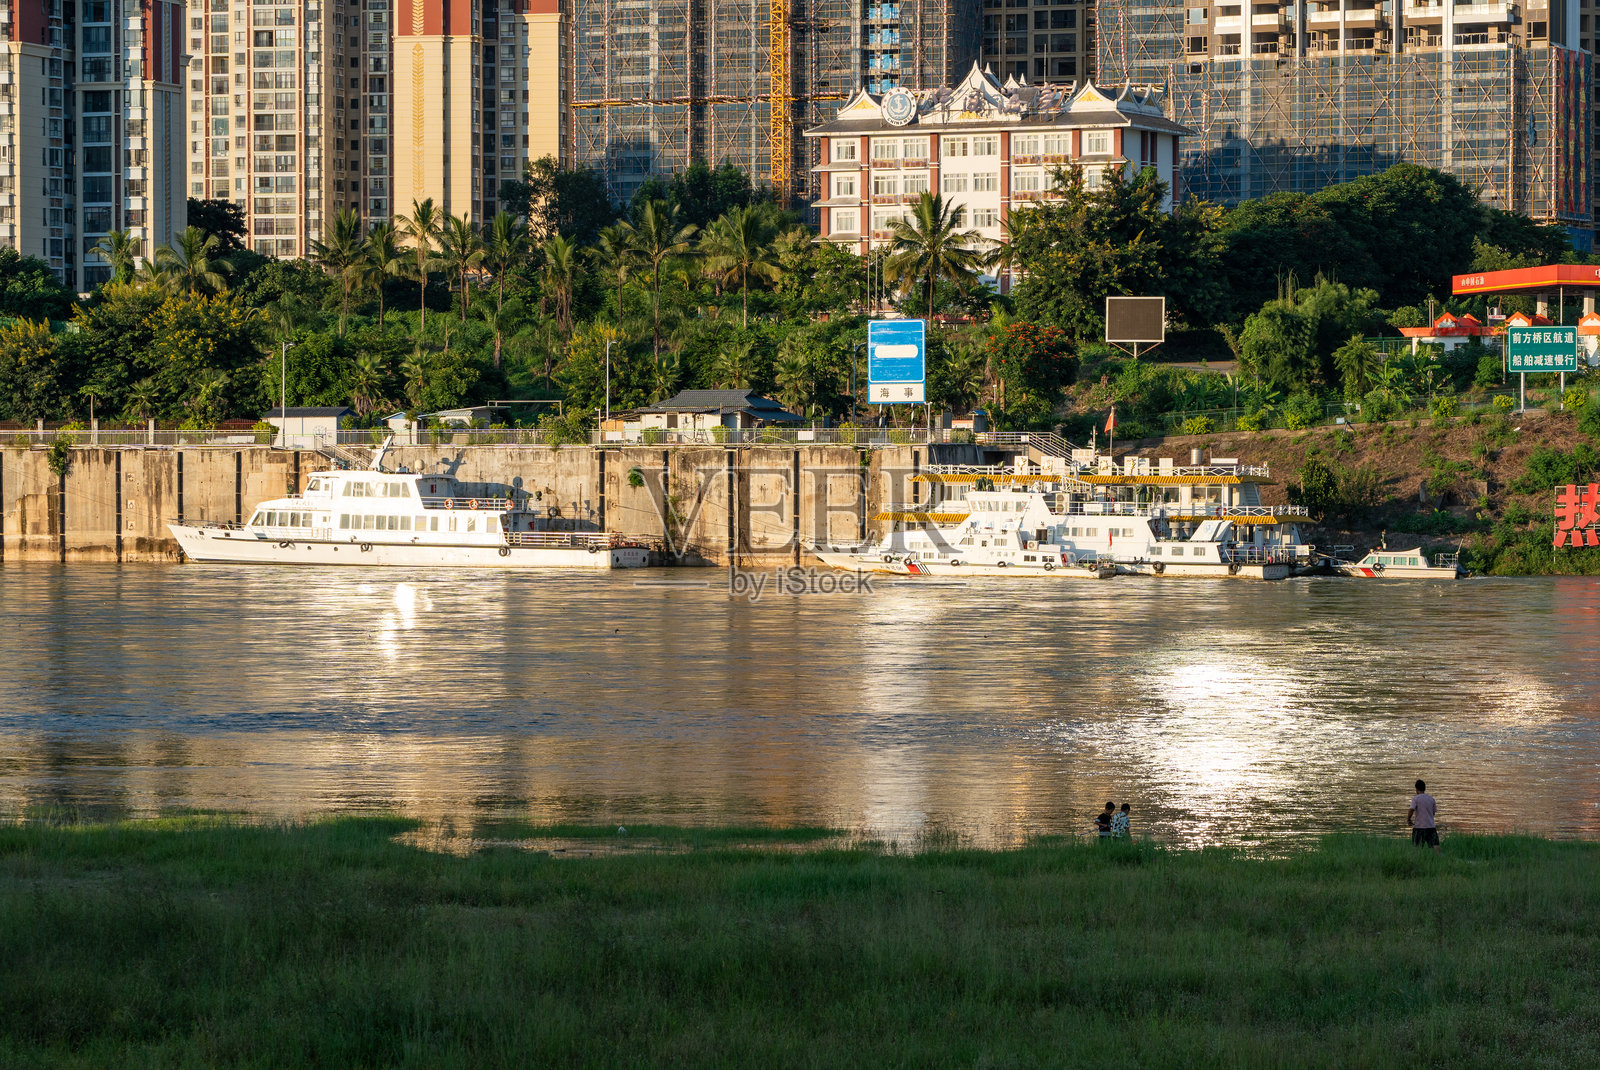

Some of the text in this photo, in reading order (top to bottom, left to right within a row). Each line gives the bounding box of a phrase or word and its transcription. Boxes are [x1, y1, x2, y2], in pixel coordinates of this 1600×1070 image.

[1512, 332, 1574, 344] 前方桥区航道
[1512, 354, 1575, 366] 船舶减速慢行
[880, 387, 913, 398] 海事
